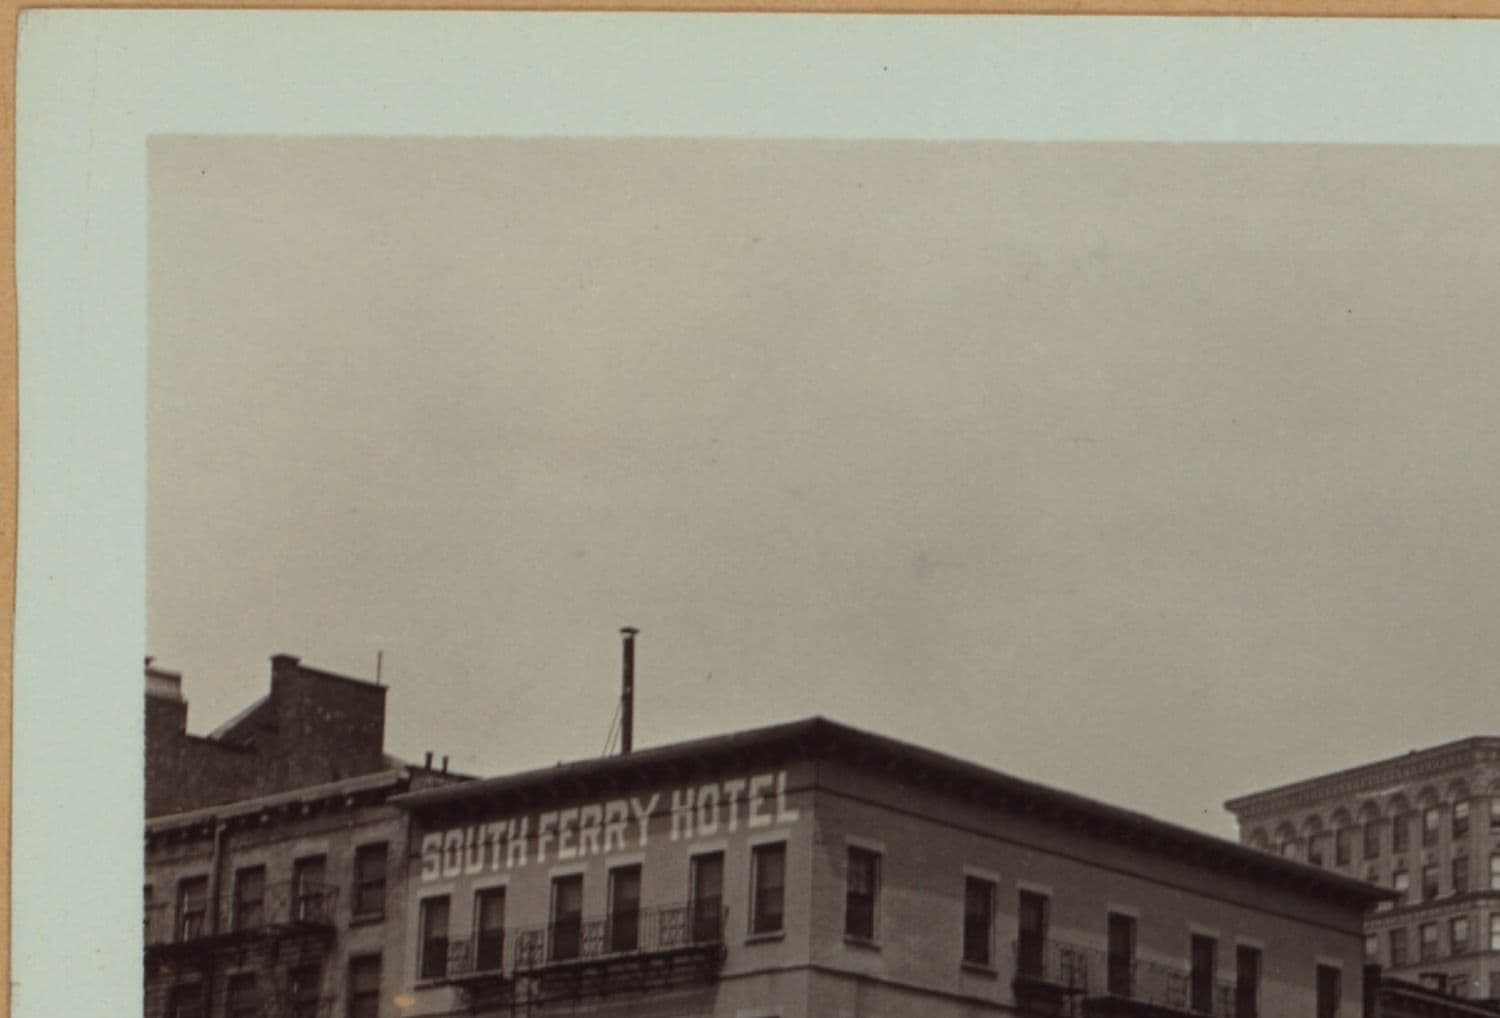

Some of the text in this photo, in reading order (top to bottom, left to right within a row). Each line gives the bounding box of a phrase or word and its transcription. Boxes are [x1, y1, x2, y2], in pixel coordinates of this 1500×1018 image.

[420, 770, 800, 883] SOUTH FERRY HOTEL
